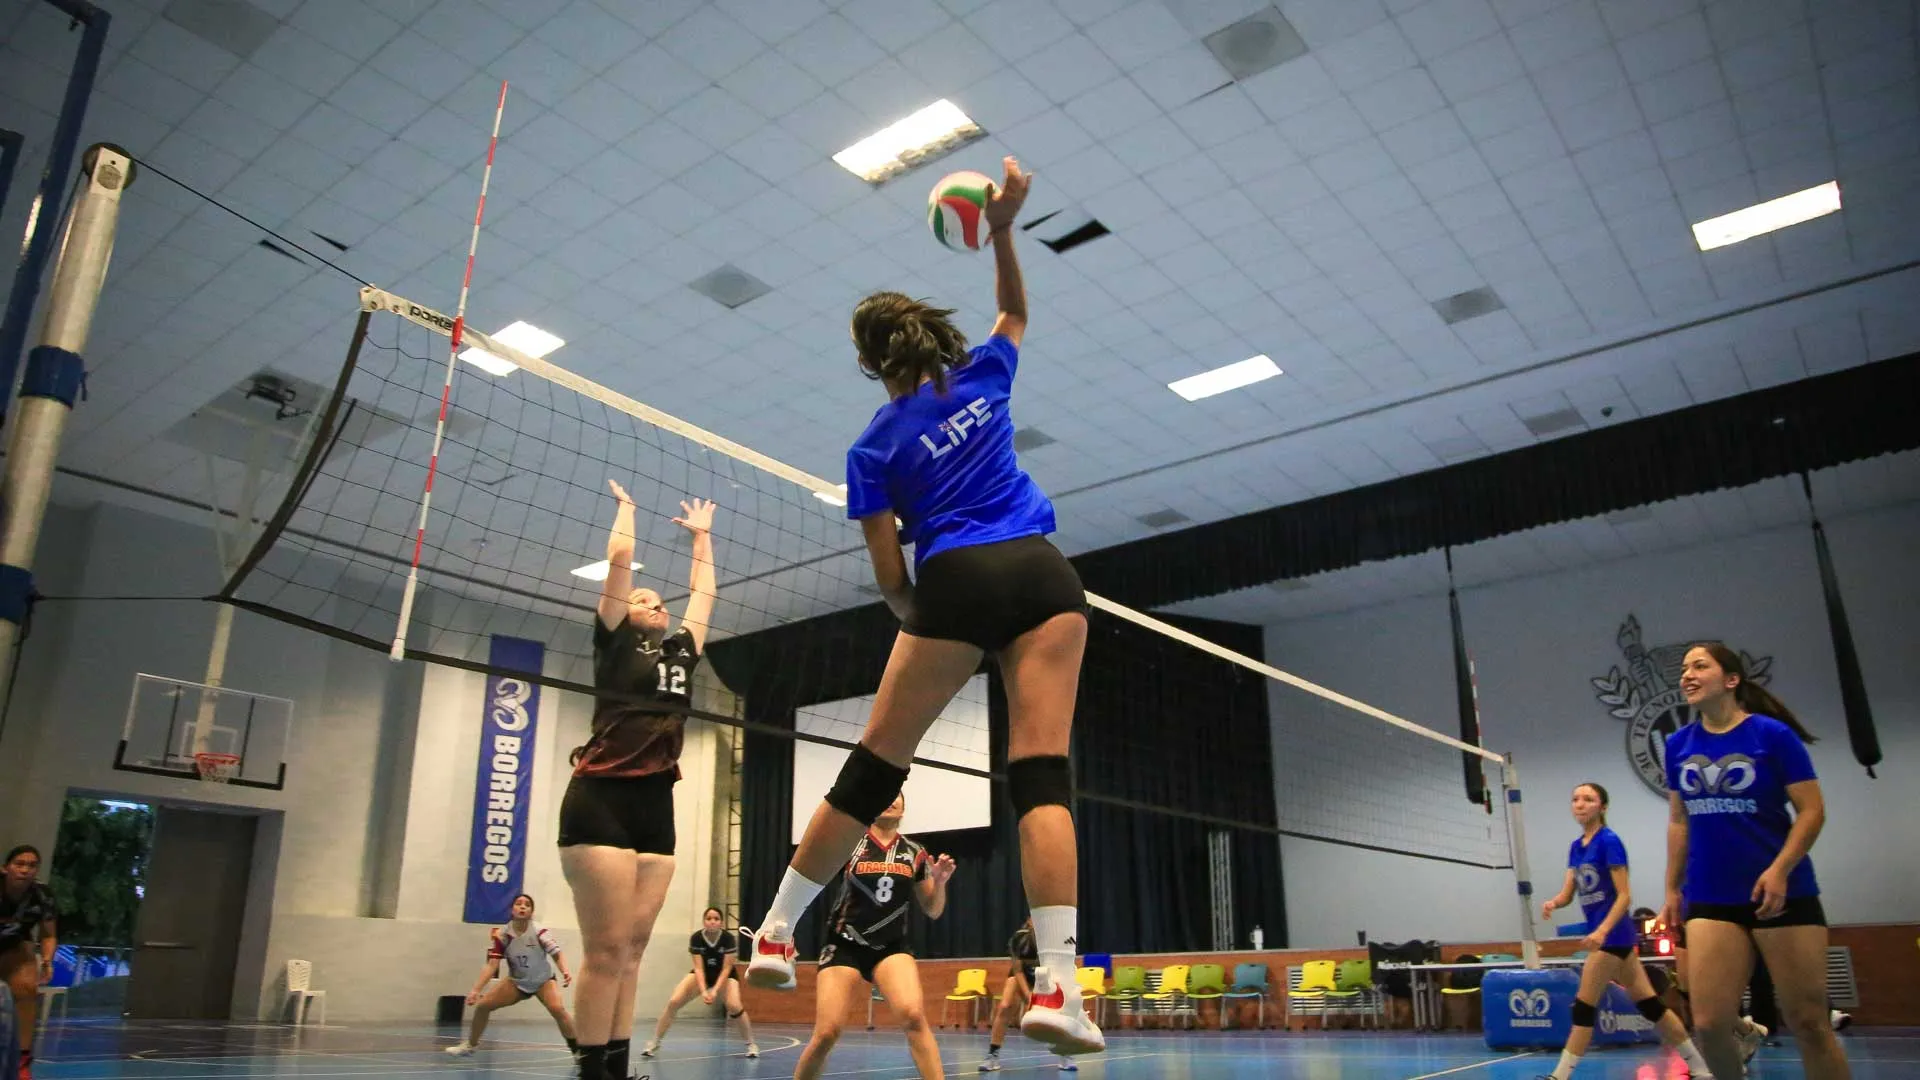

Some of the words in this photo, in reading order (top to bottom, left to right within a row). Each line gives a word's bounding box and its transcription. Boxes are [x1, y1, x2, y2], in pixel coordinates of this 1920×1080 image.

[409, 305, 454, 331] porte
[657, 662, 686, 695] 12
[482, 734, 521, 884] BORREGOS
[855, 861, 913, 878] DRAGONS
[875, 876, 894, 903] 8
